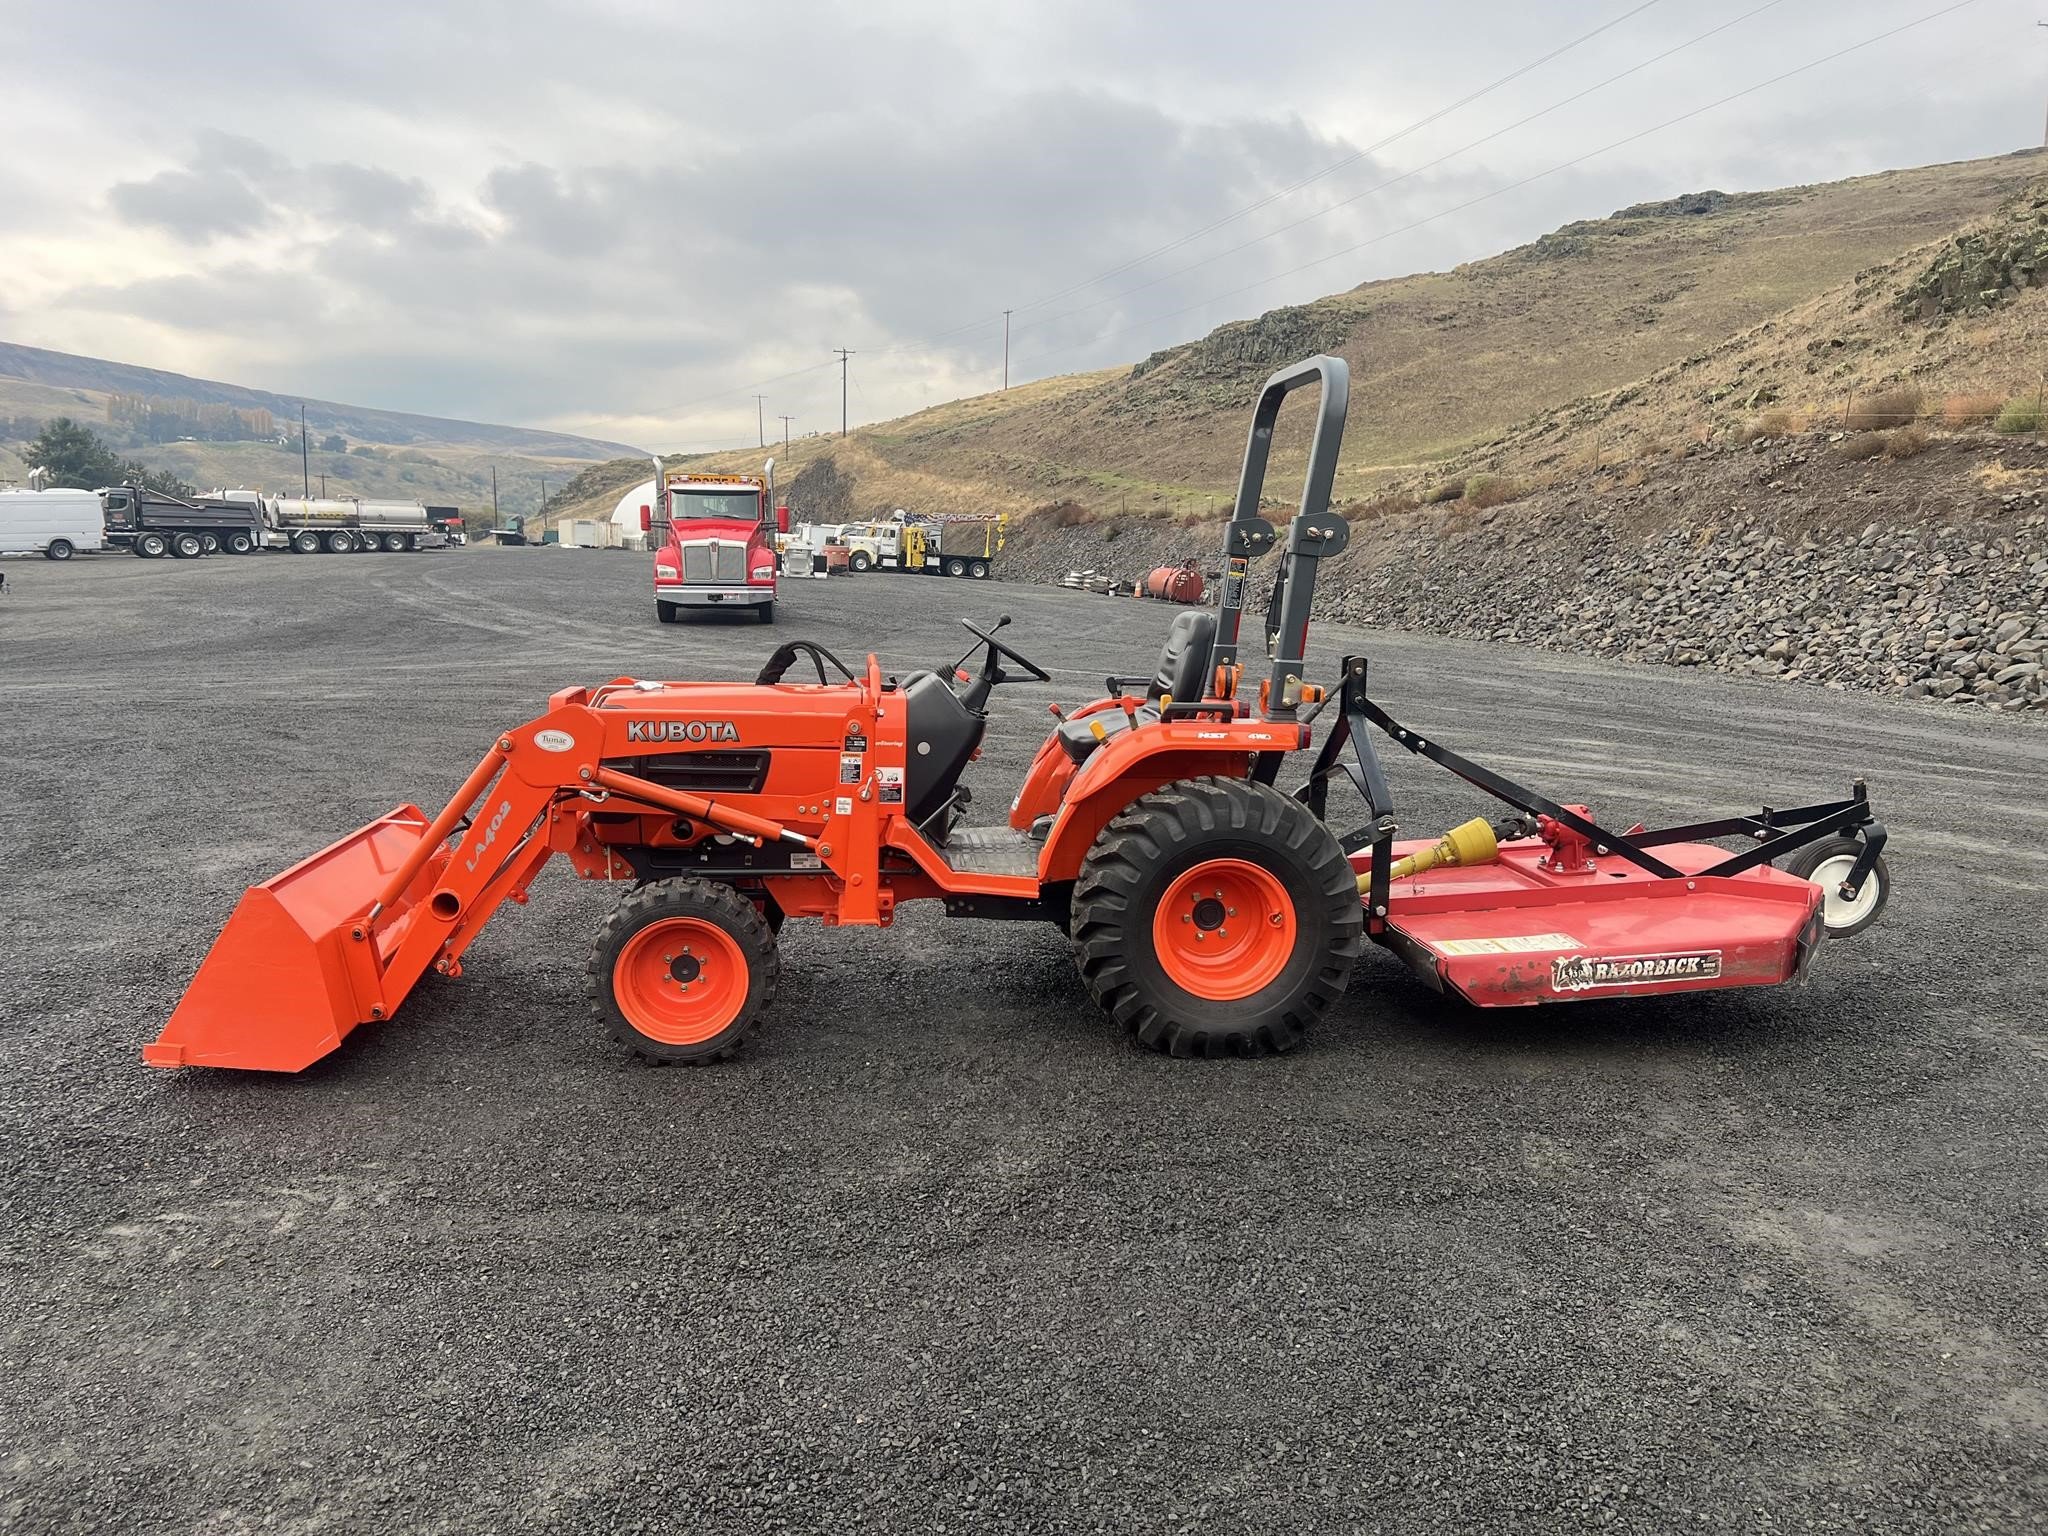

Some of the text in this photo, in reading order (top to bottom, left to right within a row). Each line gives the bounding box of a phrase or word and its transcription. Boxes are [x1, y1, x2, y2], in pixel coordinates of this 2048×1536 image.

[627, 720, 740, 742] KUBOTA
[466, 800, 512, 872] LA402
[1595, 957, 1699, 980] RAZORBACK
